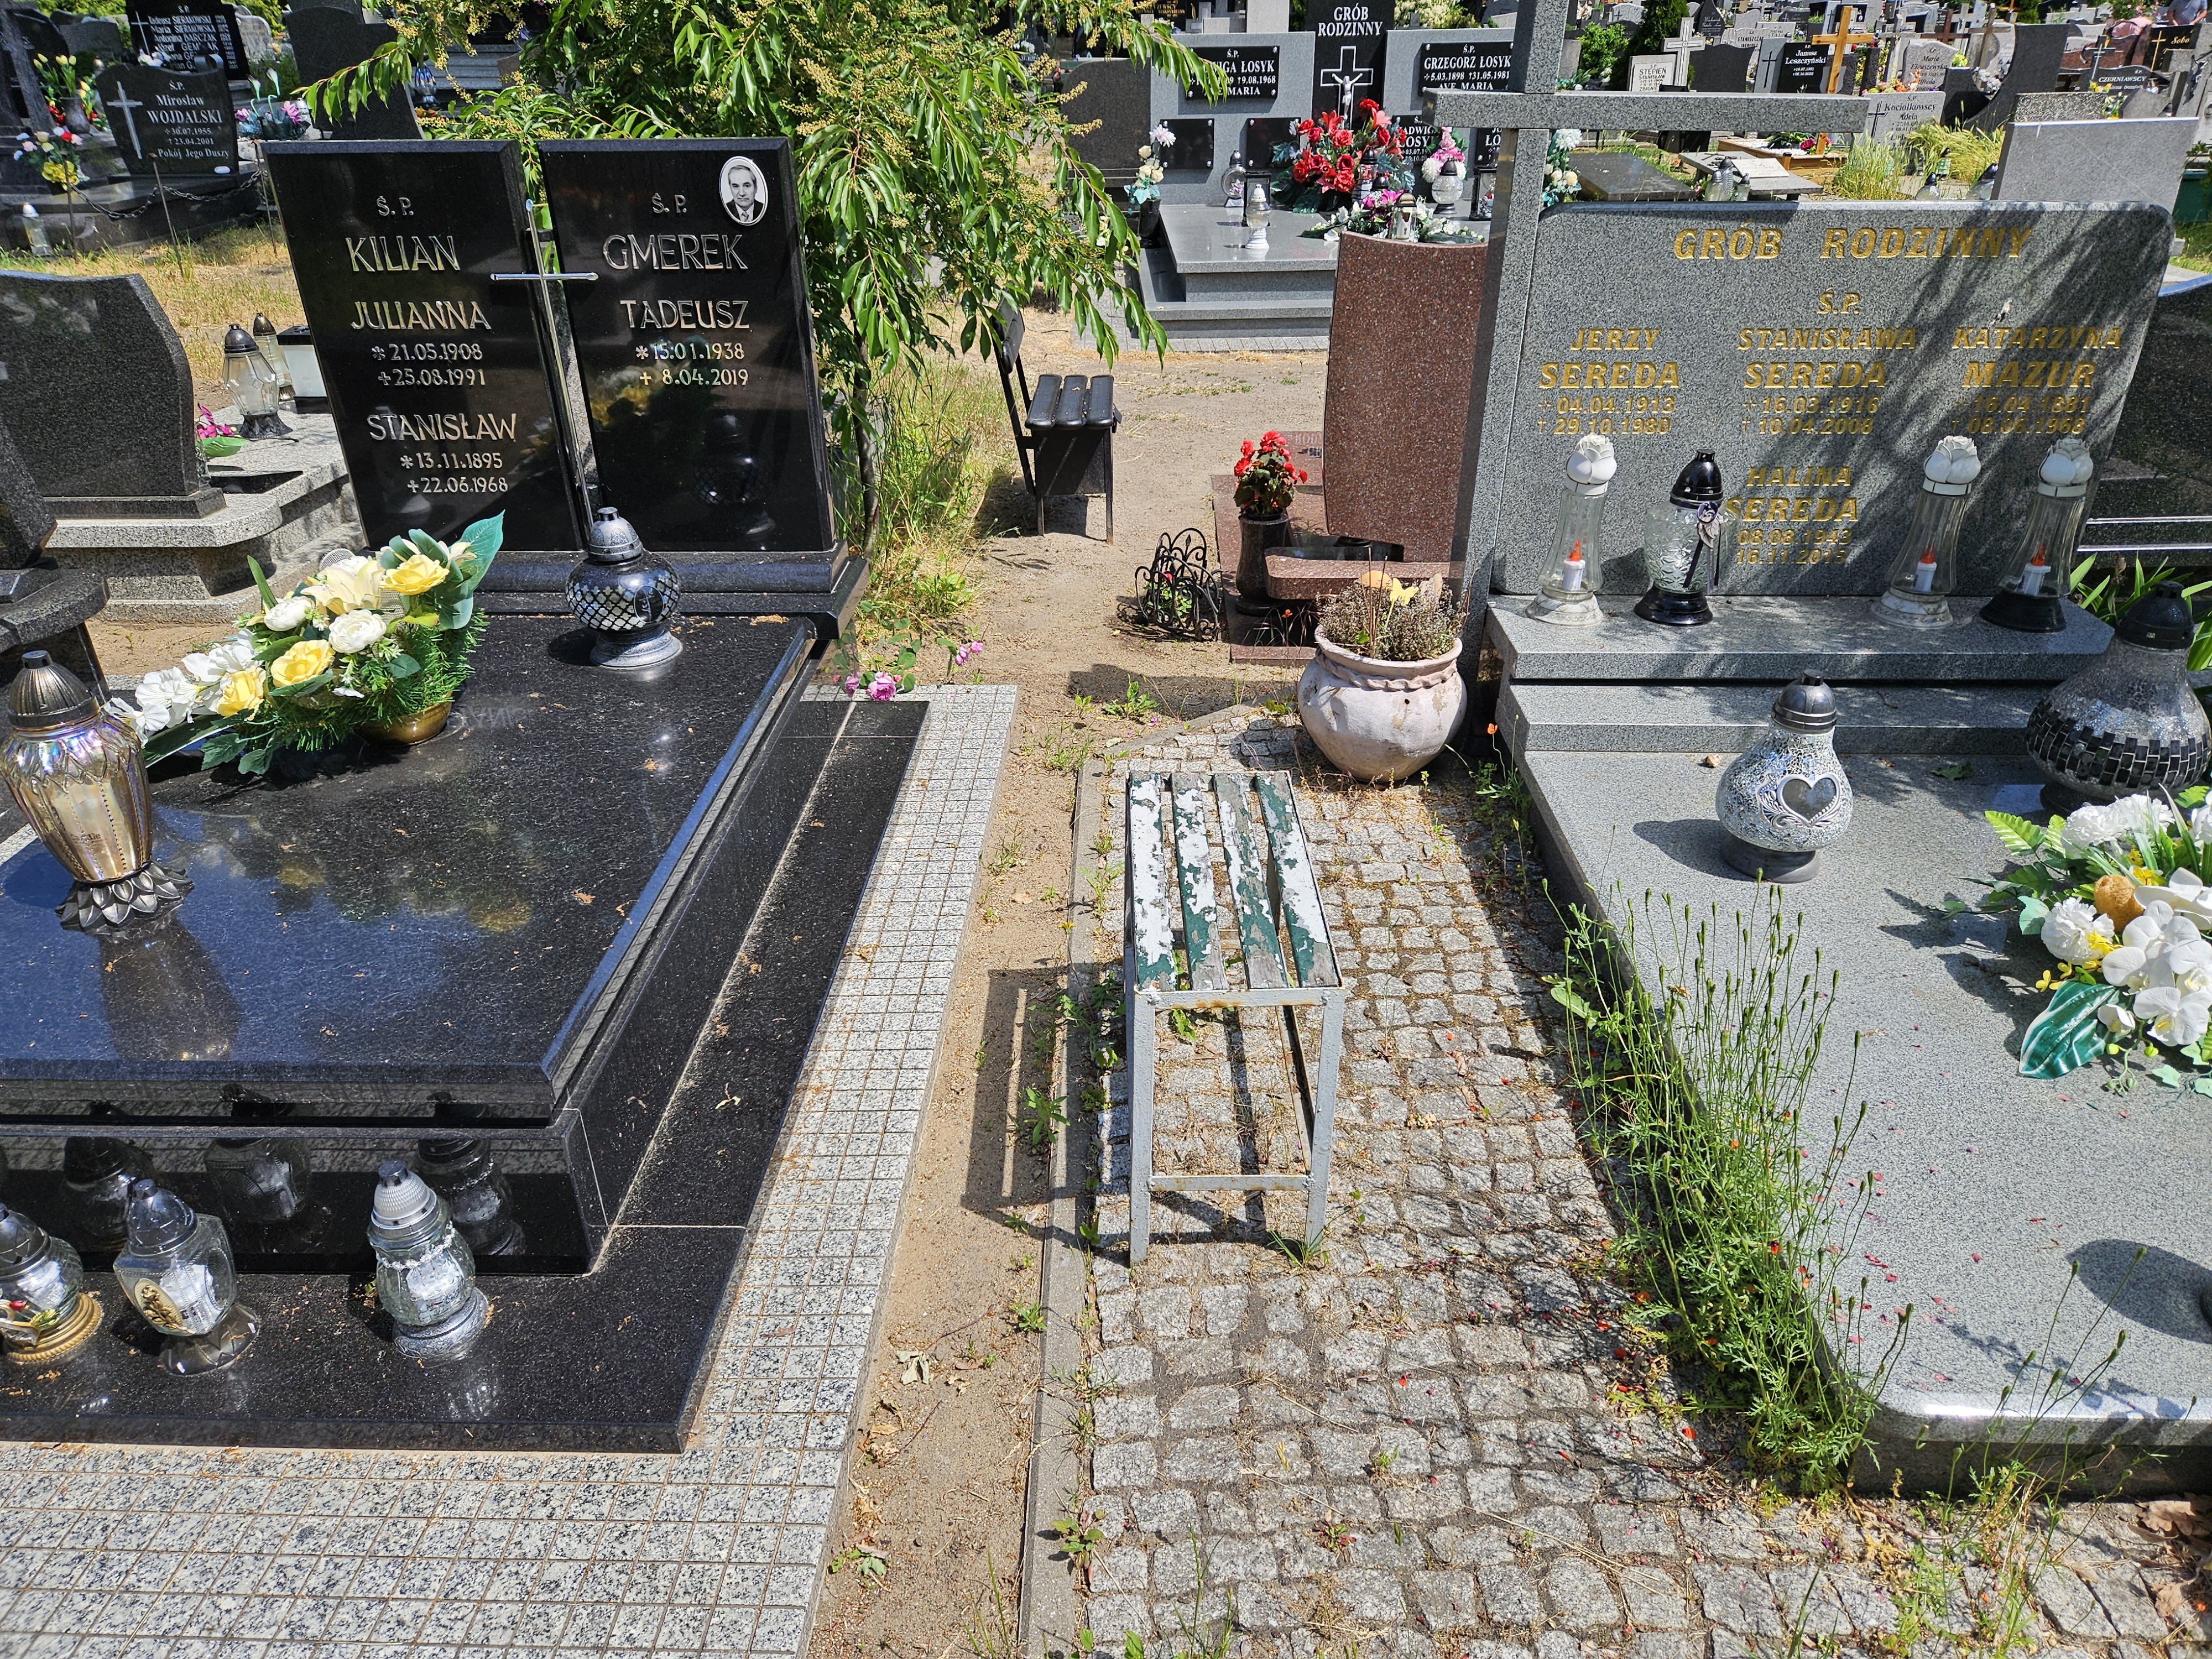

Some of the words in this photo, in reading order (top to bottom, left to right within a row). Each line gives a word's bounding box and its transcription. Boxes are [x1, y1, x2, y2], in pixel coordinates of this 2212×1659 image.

[1333, 3, 1369, 21] GRÓB
[150, 25, 171, 34] Maria
[1317, 21, 1383, 37] RODZINNY
[1241, 59, 1275, 73] ŁOSYK
[1423, 56, 1477, 70] GRZEGORZ
[1479, 55, 1512, 69] ŁOSYK
[1639, 66, 1667, 75] STĘPIEŃ
[1785, 56, 1827, 65] Leszczyński
[1228, 86, 1261, 96] MARIA
[1460, 81, 1494, 90] MARIA
[147, 109, 223, 123] WOJDALSKI
[158, 148, 182, 159] Pokój
[205, 148, 229, 159] Duszy
[1673, 219, 1783, 259] GRÓB
[1819, 227, 2032, 258] RODZINNY
[345, 236, 461, 272] KILIAN
[603, 233, 748, 270] GMEREK
[1816, 287, 1861, 315] Ś.P.
[351, 301, 492, 330] JULIANNA
[620, 300, 750, 329] TADEUSZ
[1569, 327, 1661, 351] JERZY
[1737, 327, 1916, 350] STANISŁAWA
[1951, 327, 2121, 349] KATARZYNA
[1538, 361, 1680, 389] SEREDA
[1743, 361, 1886, 389] SEREDA
[1961, 361, 2097, 388] MAZUR
[367, 413, 517, 441] STANISŁAW
[1746, 466, 1851, 487] HALINA
[1725, 497, 1859, 523] SEREDA
